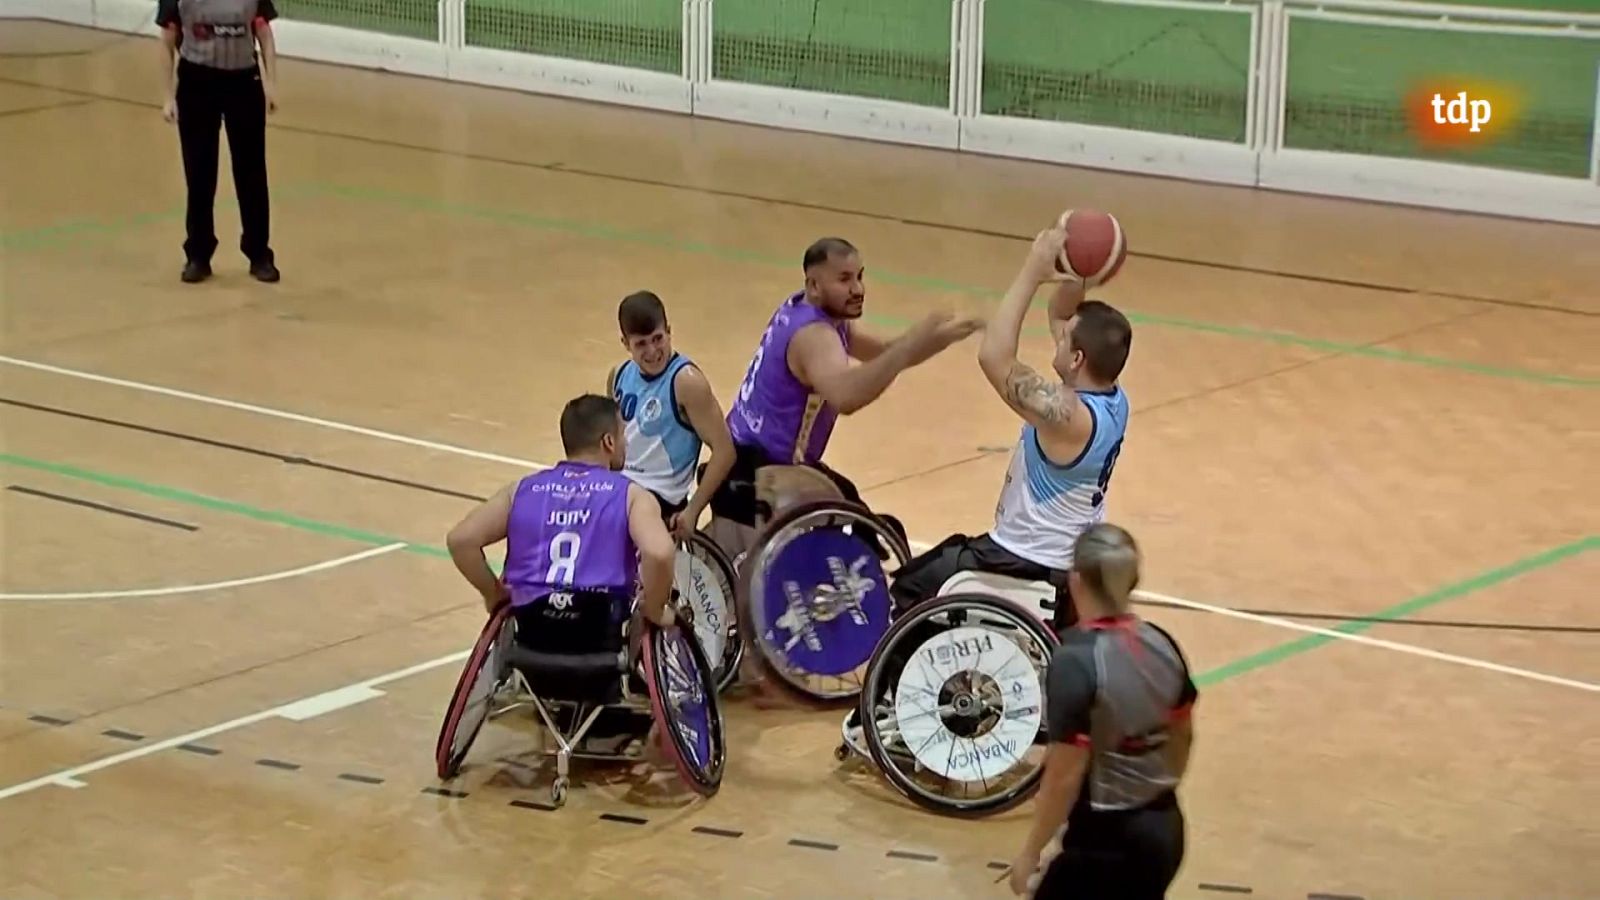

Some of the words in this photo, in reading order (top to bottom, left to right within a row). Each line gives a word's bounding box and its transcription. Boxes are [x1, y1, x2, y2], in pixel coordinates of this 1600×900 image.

[546, 510, 591, 525] JONY
[545, 532, 581, 585] 8
[692, 570, 721, 634] ABANCA
